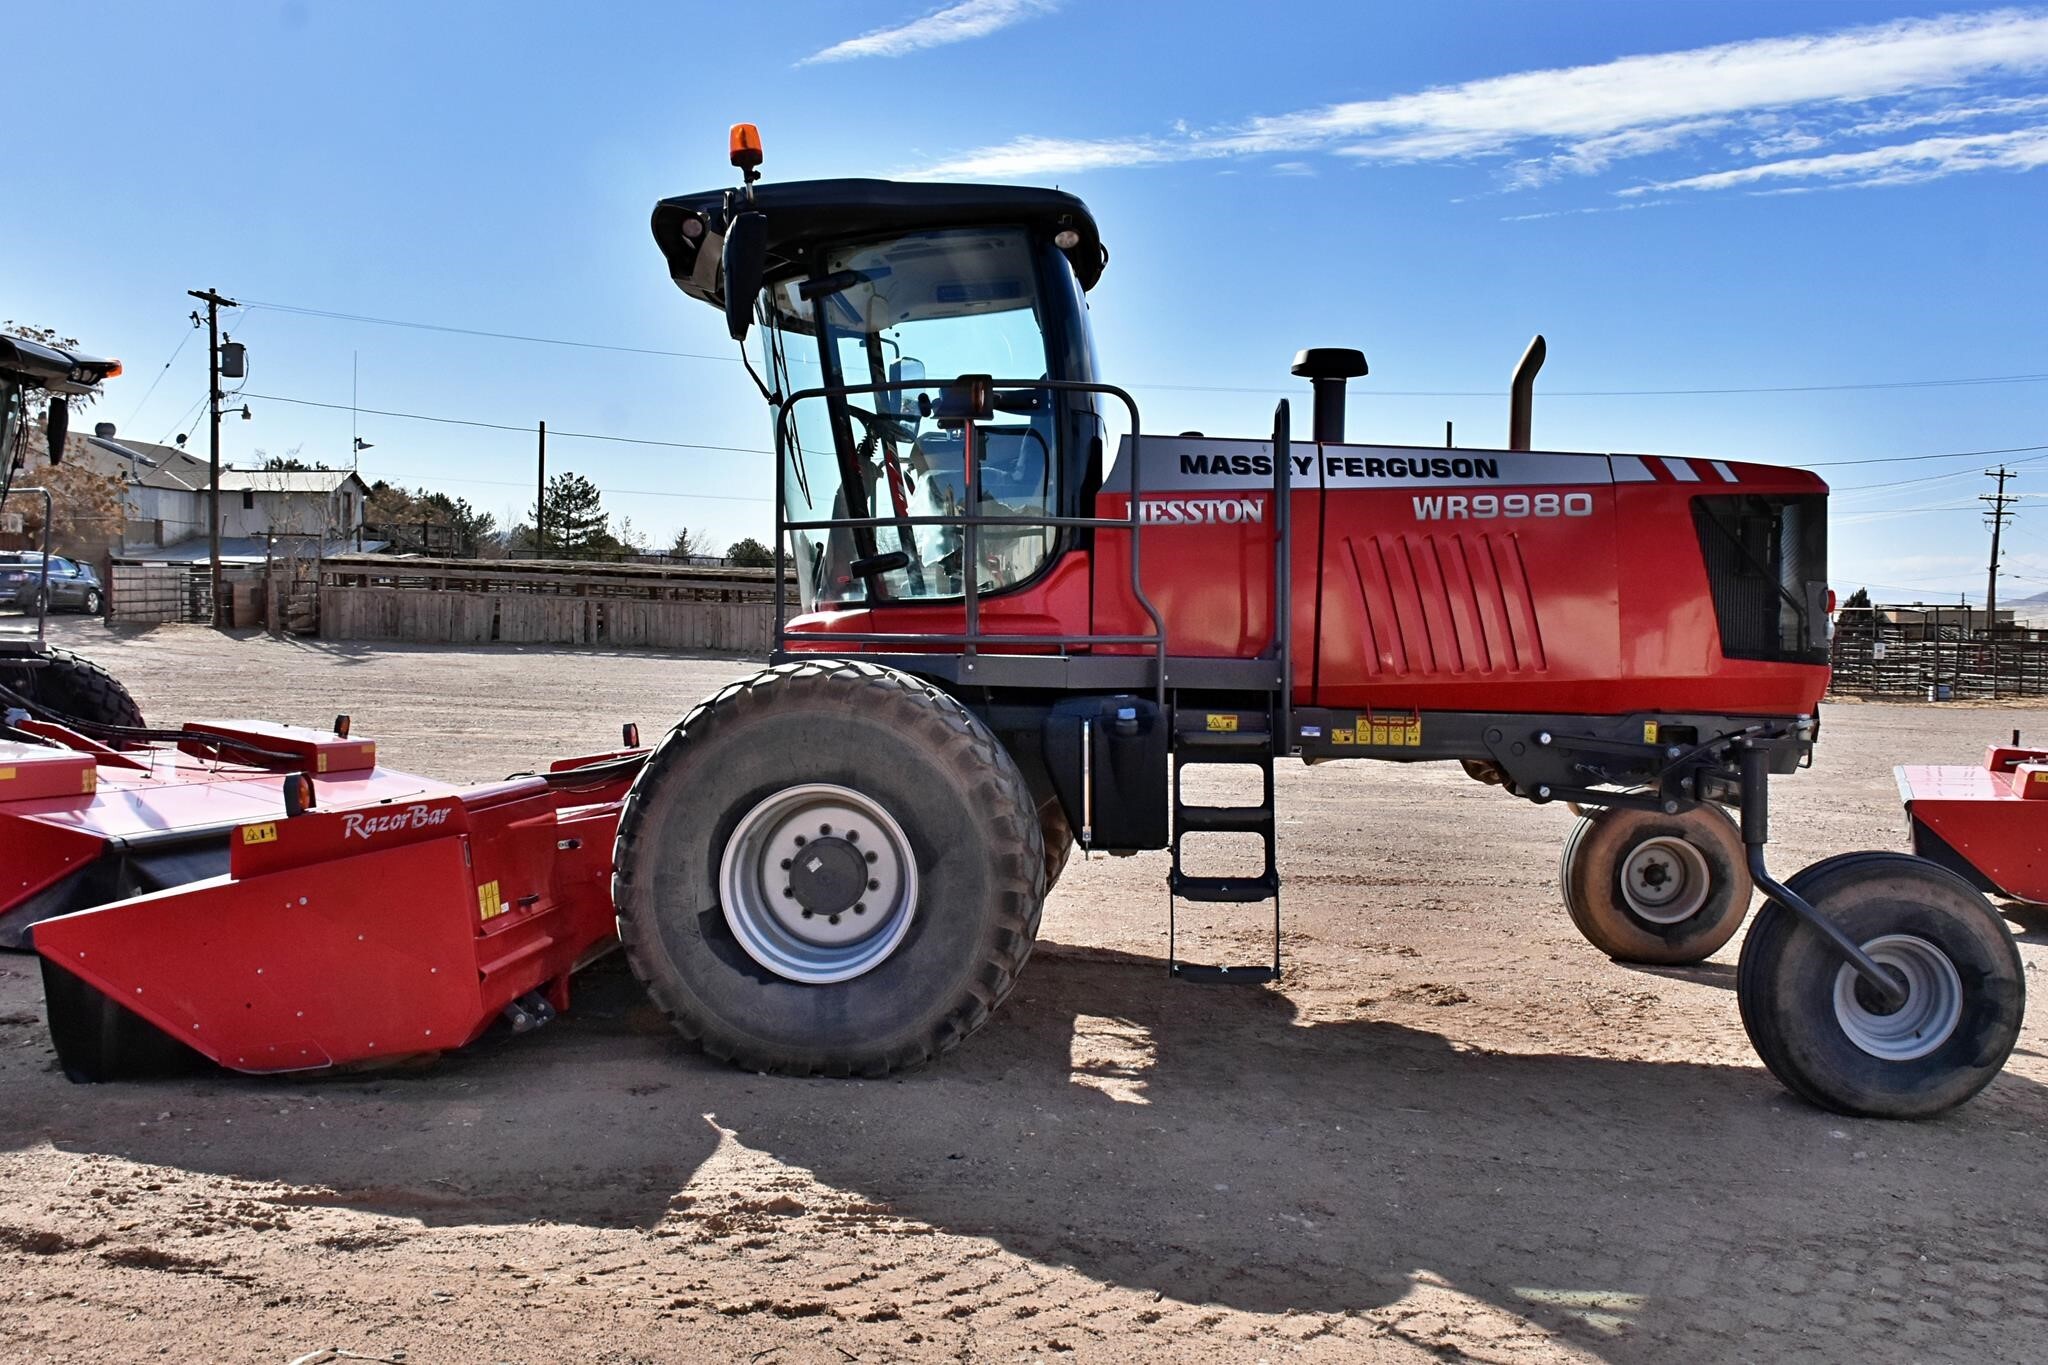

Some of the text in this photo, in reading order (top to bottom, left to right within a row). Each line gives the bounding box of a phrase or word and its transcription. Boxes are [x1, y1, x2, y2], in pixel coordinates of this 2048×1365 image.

[1180, 455, 1499, 478] MASSY FERGUSON
[1412, 493, 1592, 521] WR9980
